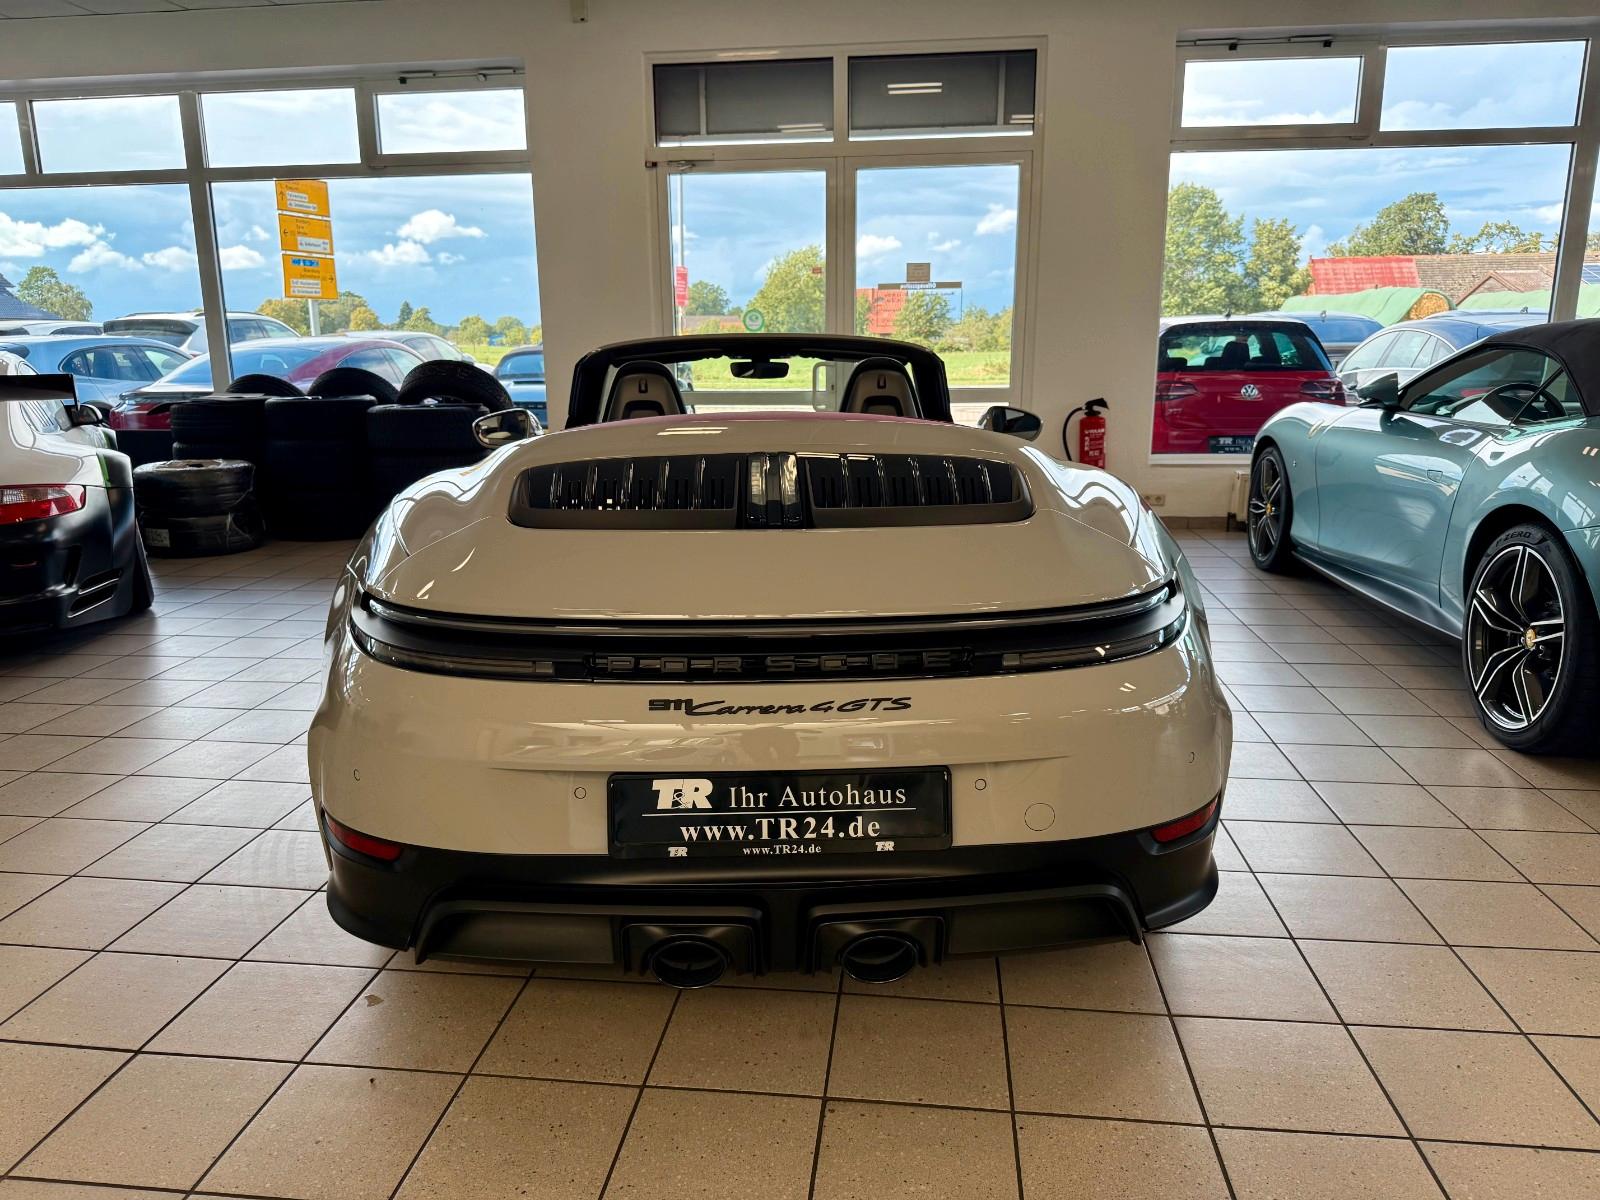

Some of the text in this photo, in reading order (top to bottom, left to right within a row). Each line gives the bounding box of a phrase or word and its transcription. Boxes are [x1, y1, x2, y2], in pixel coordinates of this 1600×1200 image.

[685, 700, 806, 716] Carrera
[809, 700, 835, 713] 4
[837, 697, 912, 712] GTS
[728, 786, 769, 808] Ihr
[778, 784, 907, 807] Autohaus
[680, 816, 881, 842] www.TR24.de
[742, 844, 822, 856] www.TR24.de
